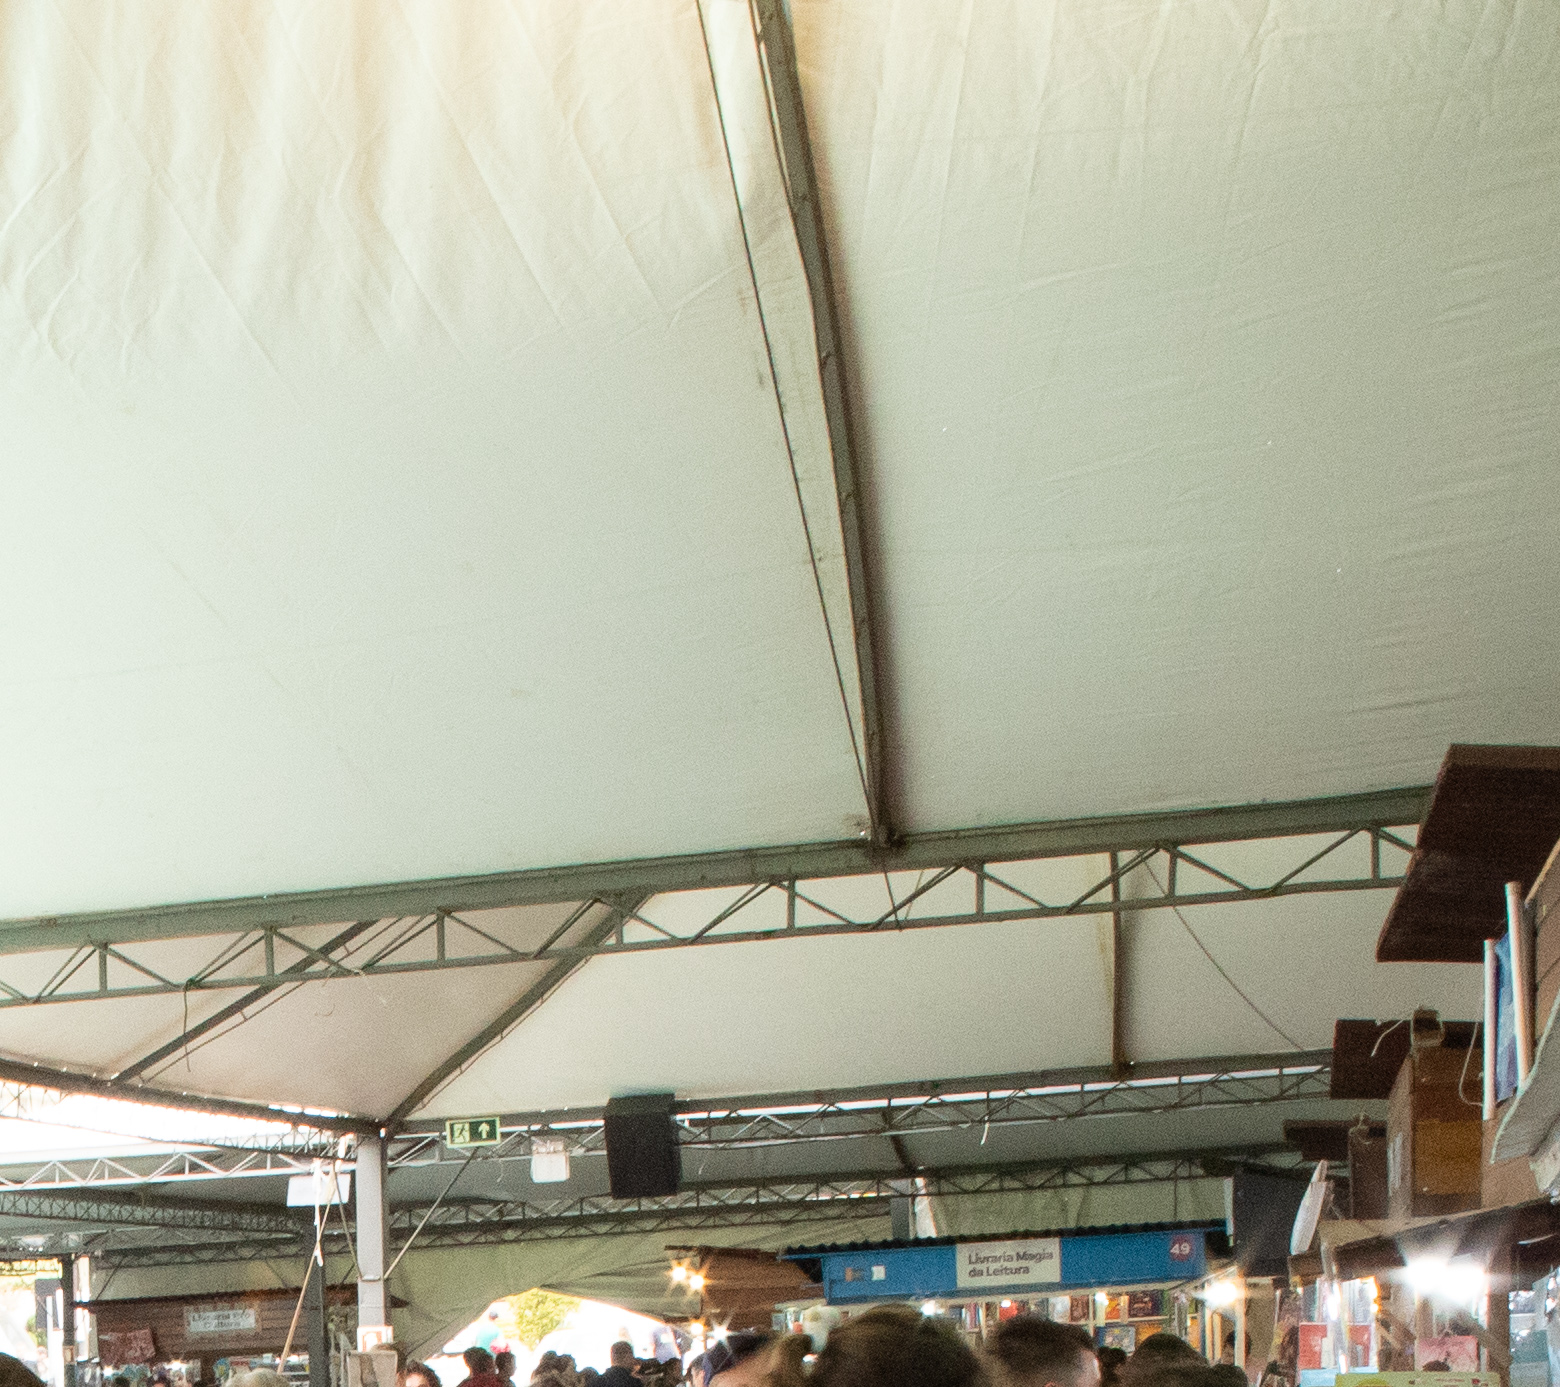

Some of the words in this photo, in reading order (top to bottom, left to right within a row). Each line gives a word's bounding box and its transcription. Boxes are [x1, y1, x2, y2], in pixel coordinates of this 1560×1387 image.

[1170, 1242, 1191, 1256] 49
[968, 1251, 1014, 1265] Livraria
[968, 1266, 984, 1278] da
[985, 1264, 1030, 1278] Leitura
